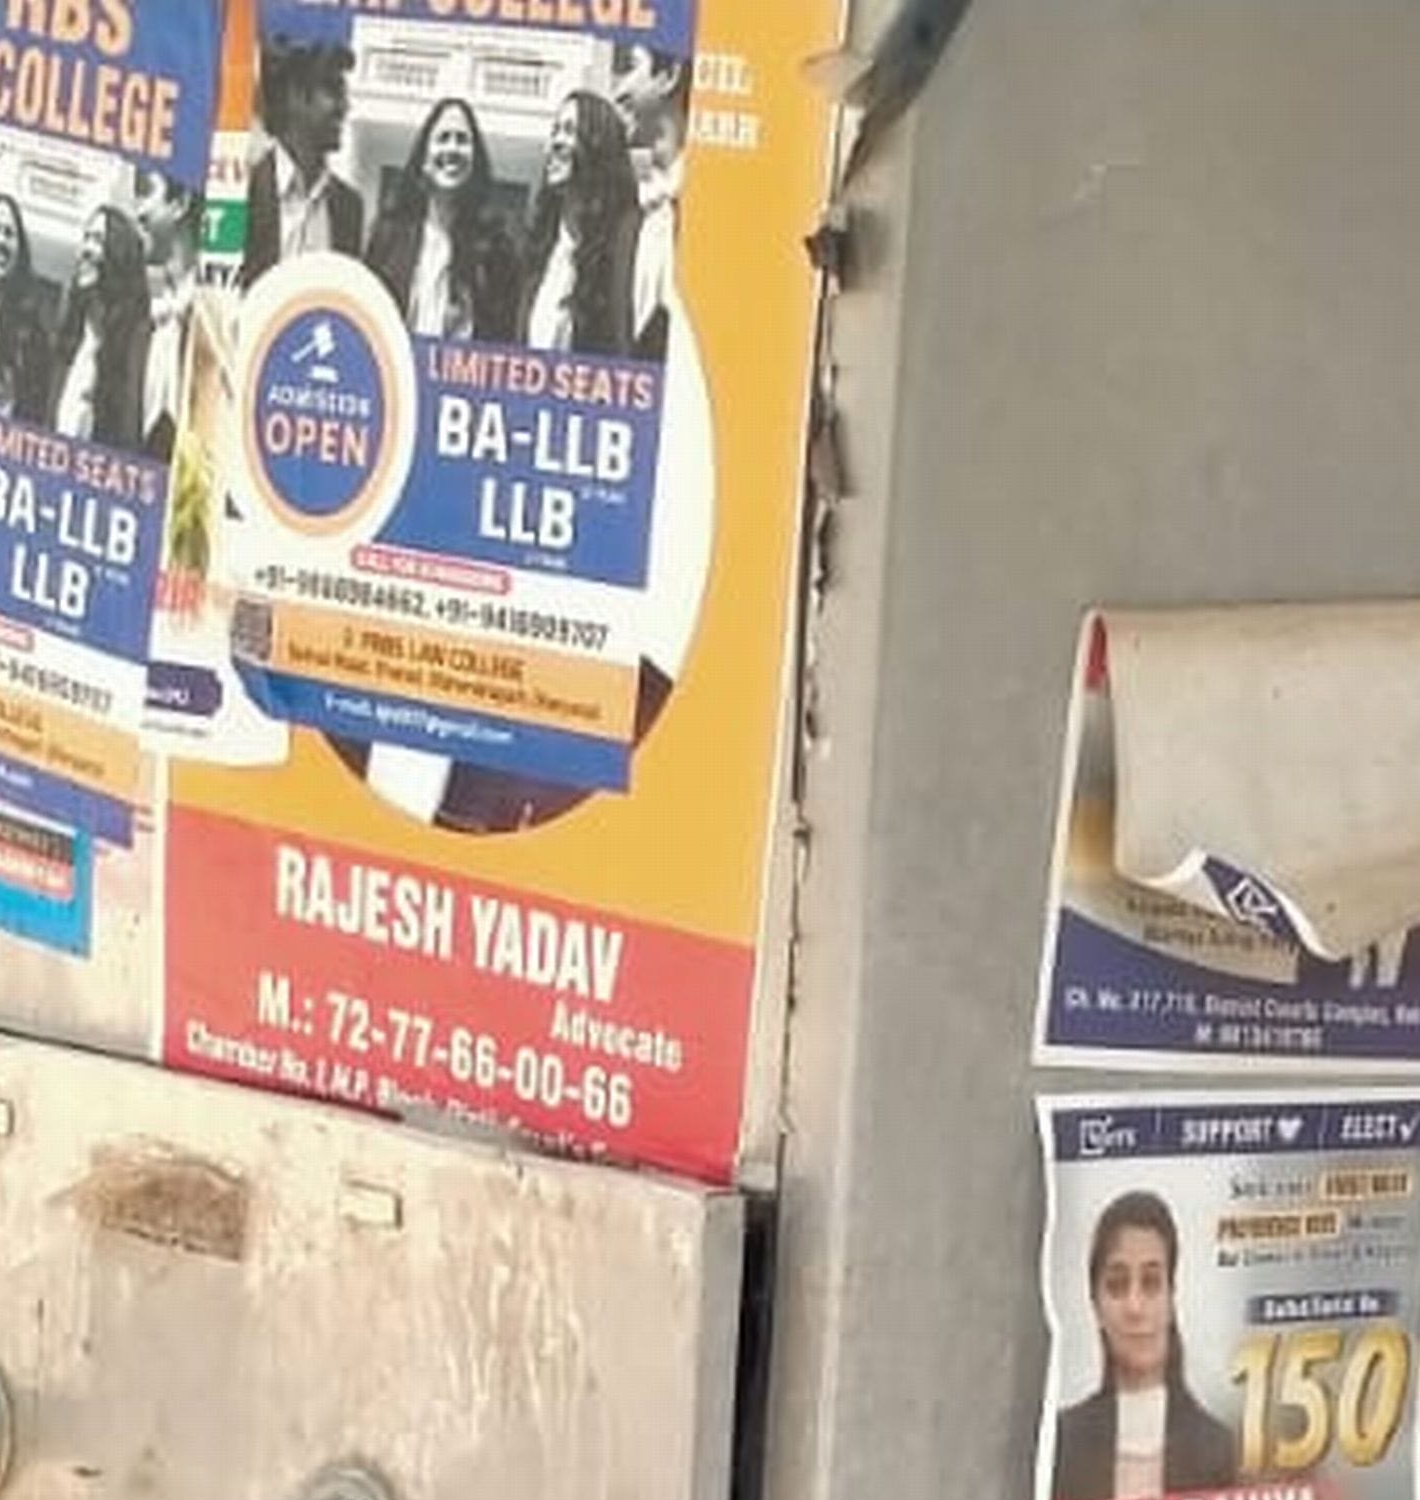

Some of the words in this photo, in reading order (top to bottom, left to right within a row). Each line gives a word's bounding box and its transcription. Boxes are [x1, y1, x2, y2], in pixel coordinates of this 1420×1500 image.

[428, 347, 544, 396] LIMITED
[551, 368, 654, 410] SEATS
[75, 448, 155, 502] SEATS
[264, 417, 370, 468] OPEN
[438, 395, 633, 484] BA-LLB
[478, 478, 575, 549] LLB
[11, 544, 90, 617] LLB
[276, 845, 454, 960] RAJESH
[471, 896, 623, 1001] YADAV
[327, 994, 633, 1126] 72-77-66-00-66
[551, 1002, 684, 1073] Advocate
[1184, 1118, 1271, 1143] SUPPORT
[1341, 1114, 1396, 1140] ELECT
[1232, 1326, 1410, 1471] 150
